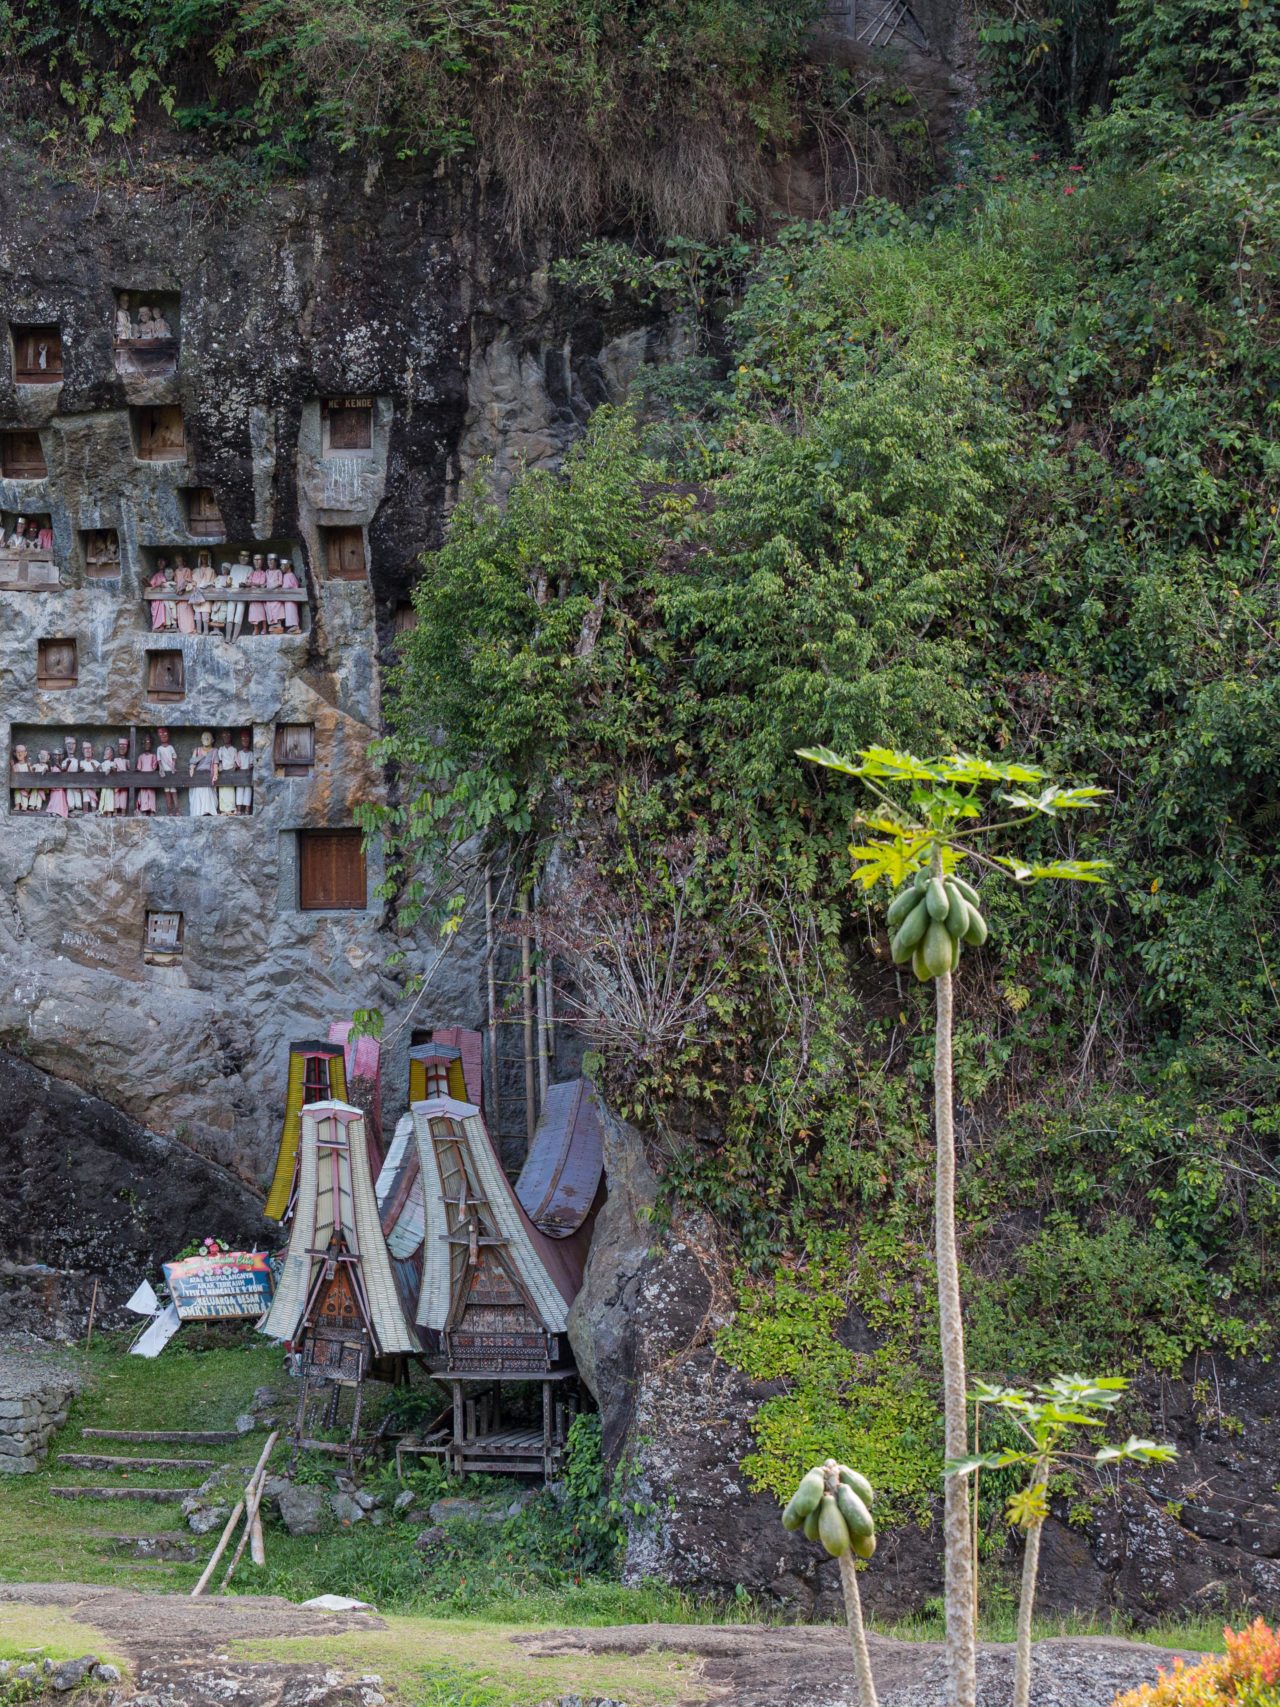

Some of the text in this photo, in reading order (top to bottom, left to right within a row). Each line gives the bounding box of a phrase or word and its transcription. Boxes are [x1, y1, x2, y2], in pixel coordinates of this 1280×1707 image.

[196, 1293, 260, 1306] KELUARGA BESAR
[181, 1305, 209, 1316] SMKN
[217, 1304, 241, 1315] TANA
[243, 1302, 271, 1314] TORA
